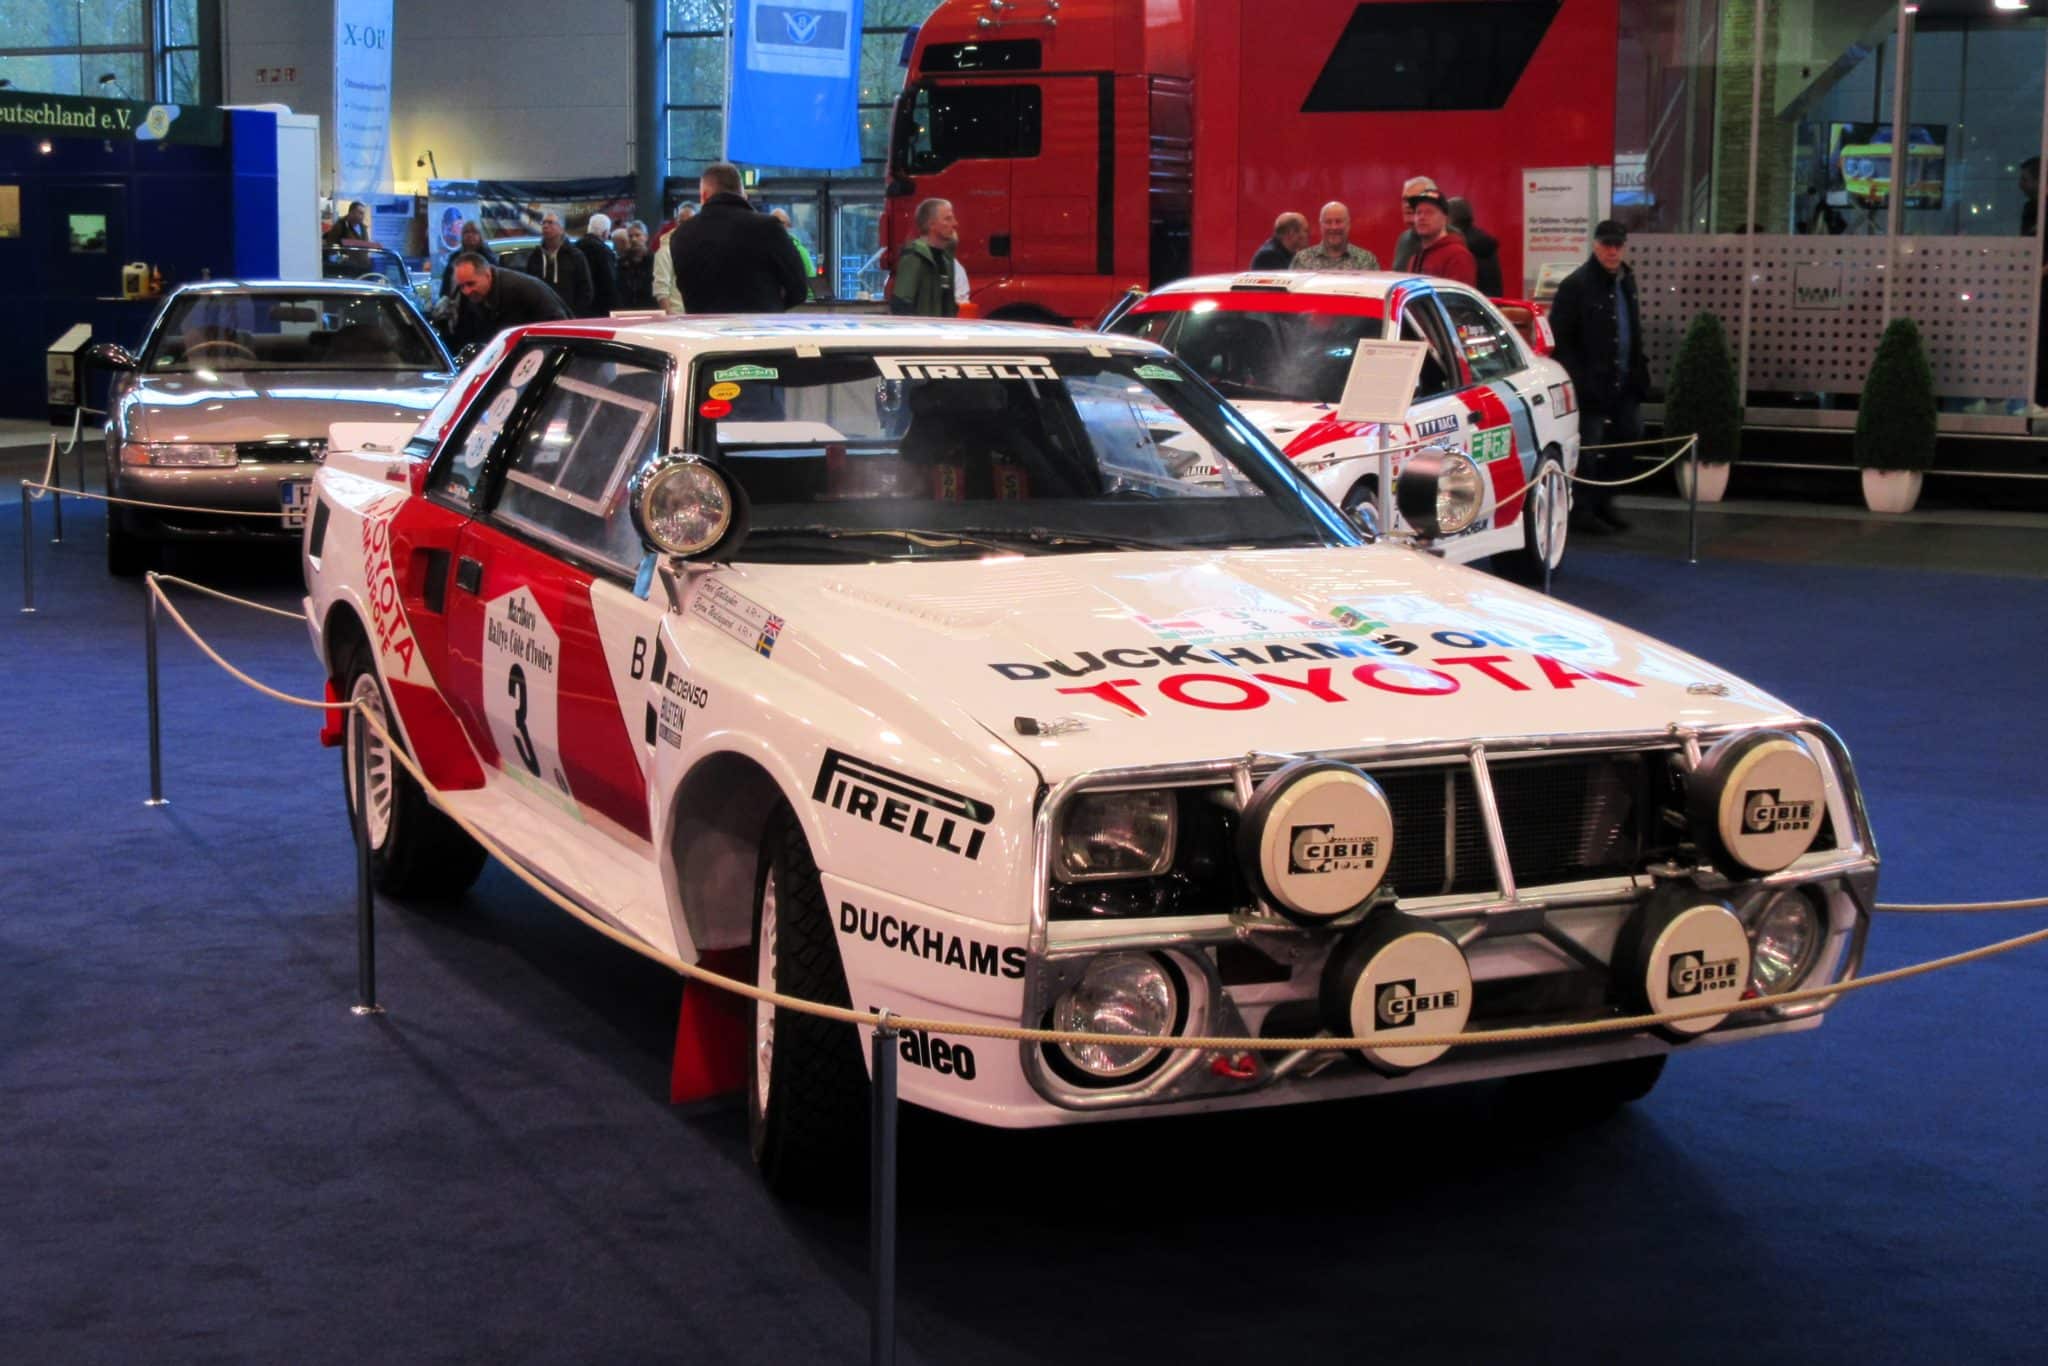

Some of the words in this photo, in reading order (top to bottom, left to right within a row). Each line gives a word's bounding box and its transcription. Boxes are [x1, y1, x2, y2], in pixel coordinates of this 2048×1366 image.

[873, 356, 1060, 380] PIRELLI
[488, 617, 508, 653] Rallye
[508, 597, 536, 632] Marlboro
[630, 635, 647, 681] B
[987, 634, 1419, 681] DUCKHAMS
[677, 679, 708, 709] DENSO
[1055, 654, 1646, 717] TOYOTA
[508, 663, 541, 778] 3
[812, 747, 995, 861] PIRELLI
[840, 901, 1030, 979] DUCKHAMS
